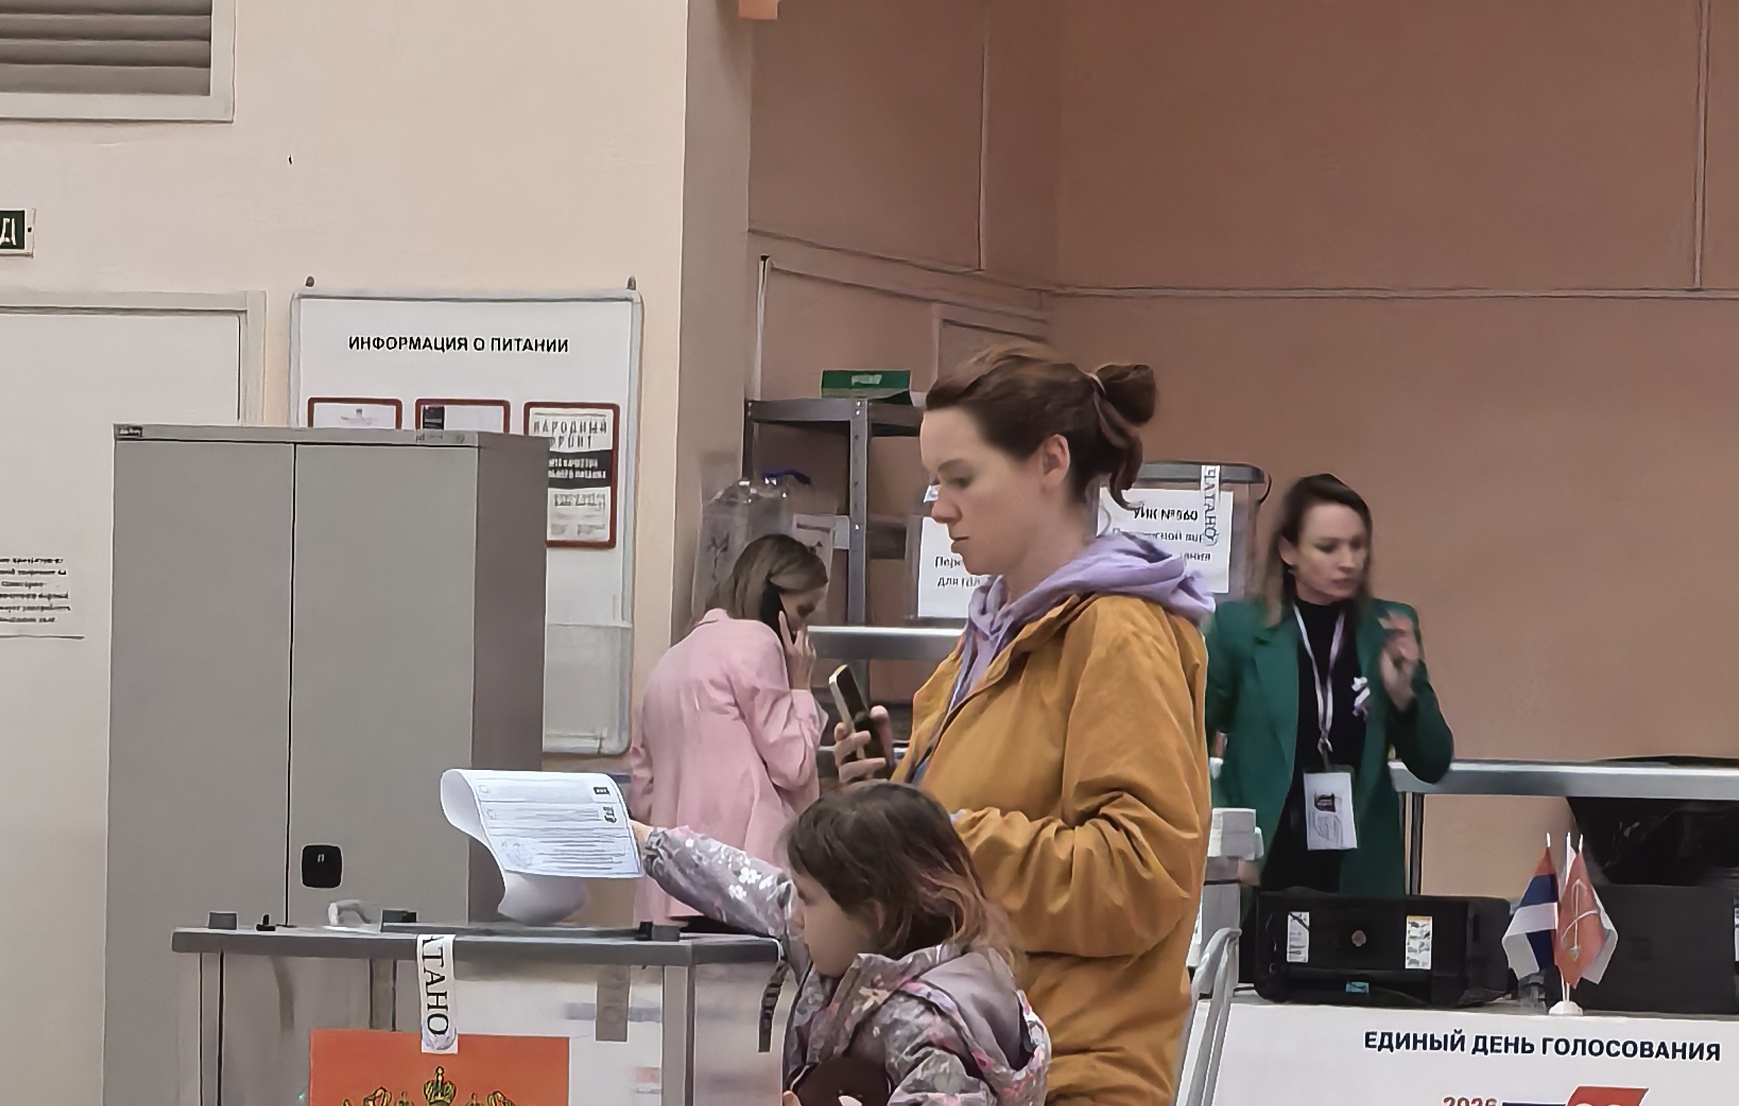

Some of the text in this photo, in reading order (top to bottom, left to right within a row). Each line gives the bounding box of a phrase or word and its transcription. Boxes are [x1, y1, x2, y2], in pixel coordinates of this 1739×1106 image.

[348, 335, 570, 353] ИНФОРМАЦИЯ О ПИТАНИИ
[1363, 1028, 1722, 1062] ЕДИНЫЙ ДЕНЬ ГОЛОСОВАНИЯ
